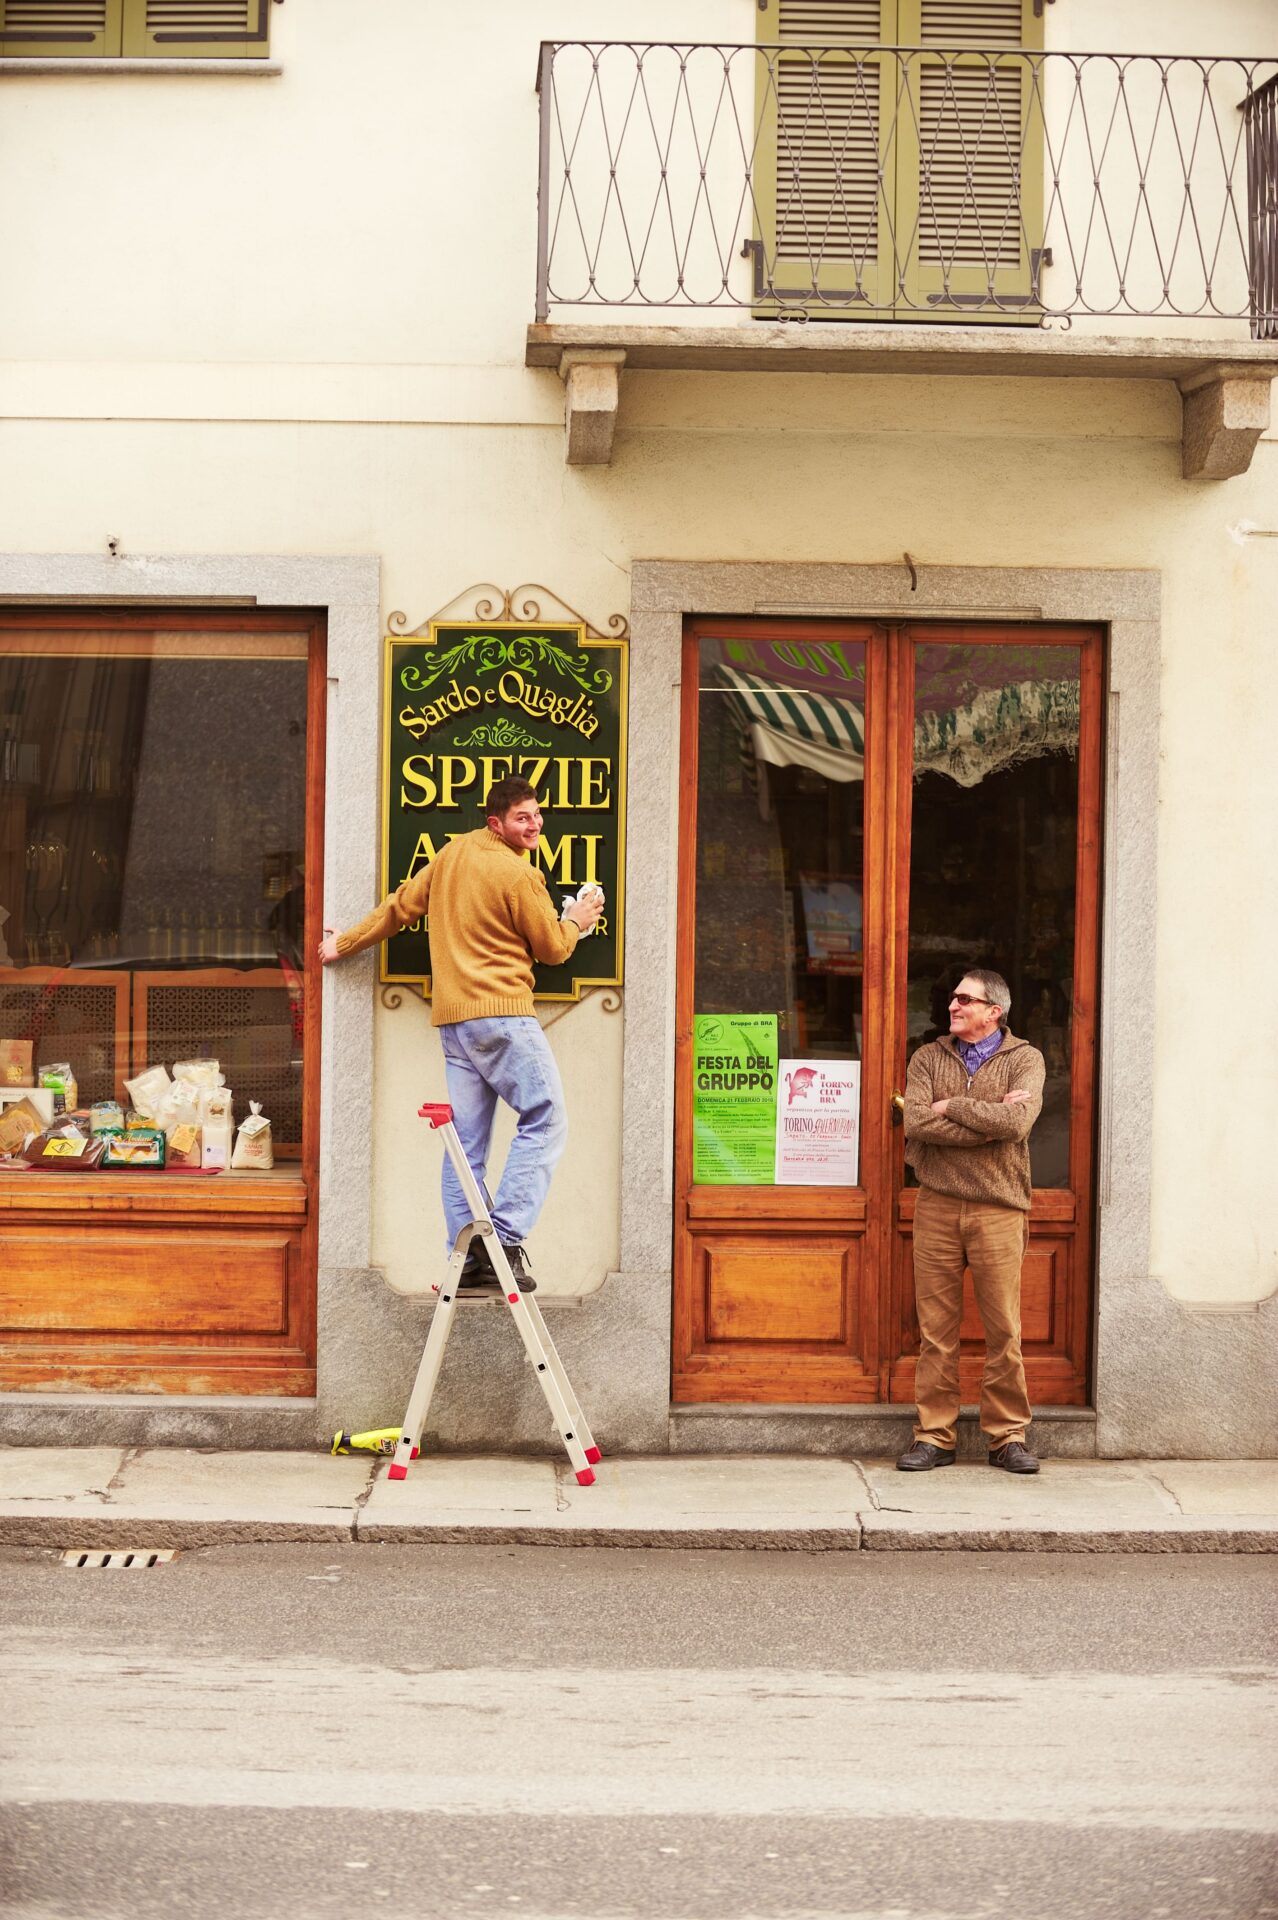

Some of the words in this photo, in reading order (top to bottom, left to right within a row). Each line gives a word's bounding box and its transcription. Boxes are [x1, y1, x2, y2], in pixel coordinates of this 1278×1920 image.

[399, 679, 481, 740] Sardo
[484, 687, 497, 703] e
[498, 670, 599, 740] Quaglia
[698, 1056, 741, 1069] FESTA
[746, 1056, 773, 1069] DEL
[697, 1073, 773, 1090] GRUPPO
[820, 1081, 854, 1089] TORINO
[819, 1096, 836, 1104] BRA
[783, 1117, 813, 1132] TORINO
